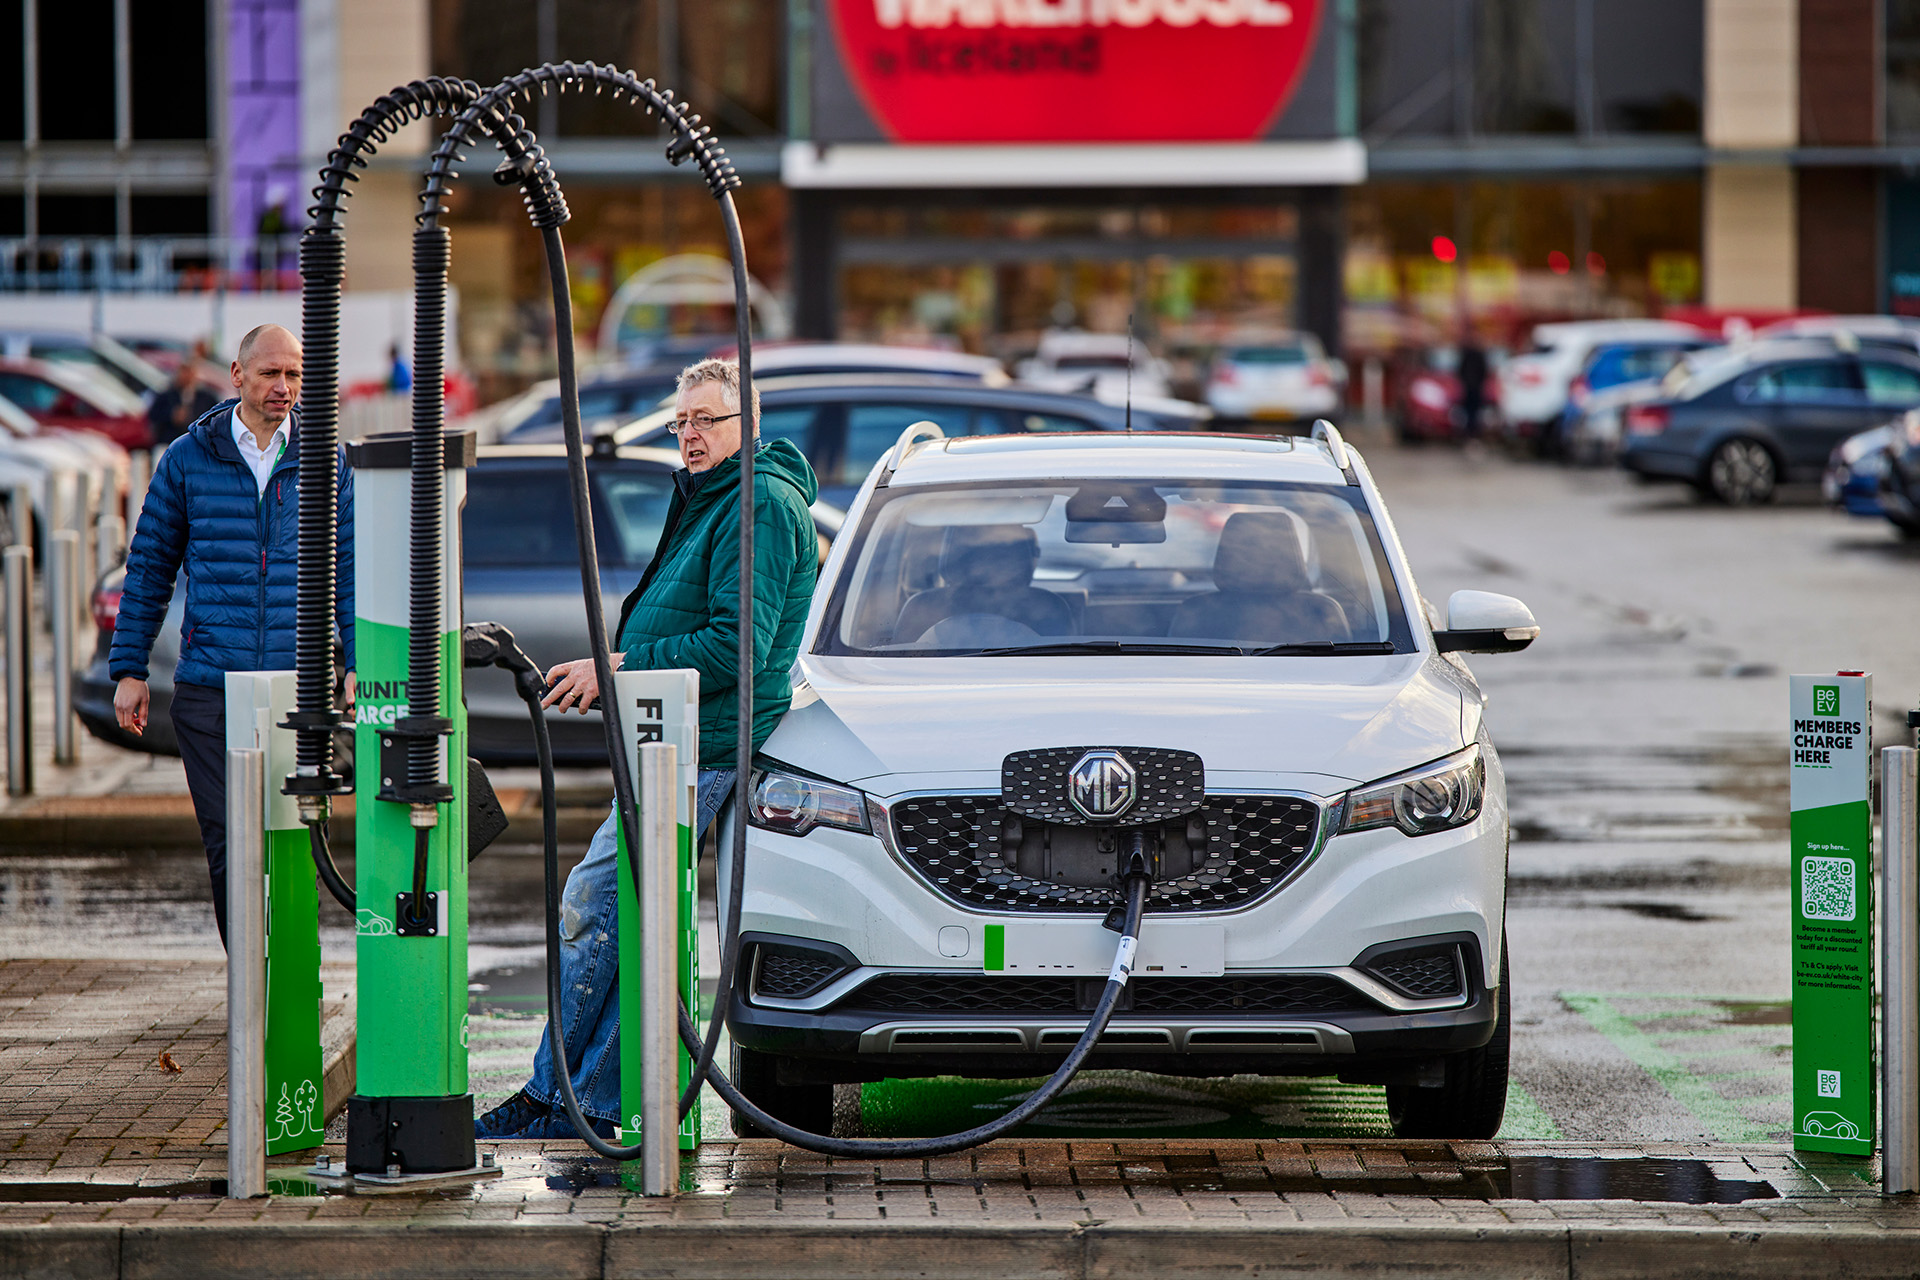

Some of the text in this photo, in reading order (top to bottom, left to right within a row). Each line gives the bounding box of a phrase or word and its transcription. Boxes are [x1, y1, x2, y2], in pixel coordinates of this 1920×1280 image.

[1817, 701, 1835, 712] EV
[1794, 720, 1861, 734] MEMBERS
[1794, 735, 1853, 749] CHARGE
[1794, 750, 1830, 763] HERE
[1076, 760, 1129, 812] MG
[1807, 842, 1820, 850] Sign
[1830, 843, 1850, 851] here...
[1796, 934, 1813, 942] today
[1829, 936, 1863, 944] discounted
[1825, 982, 1862, 990] information.
[1821, 1084, 1836, 1093] EV
